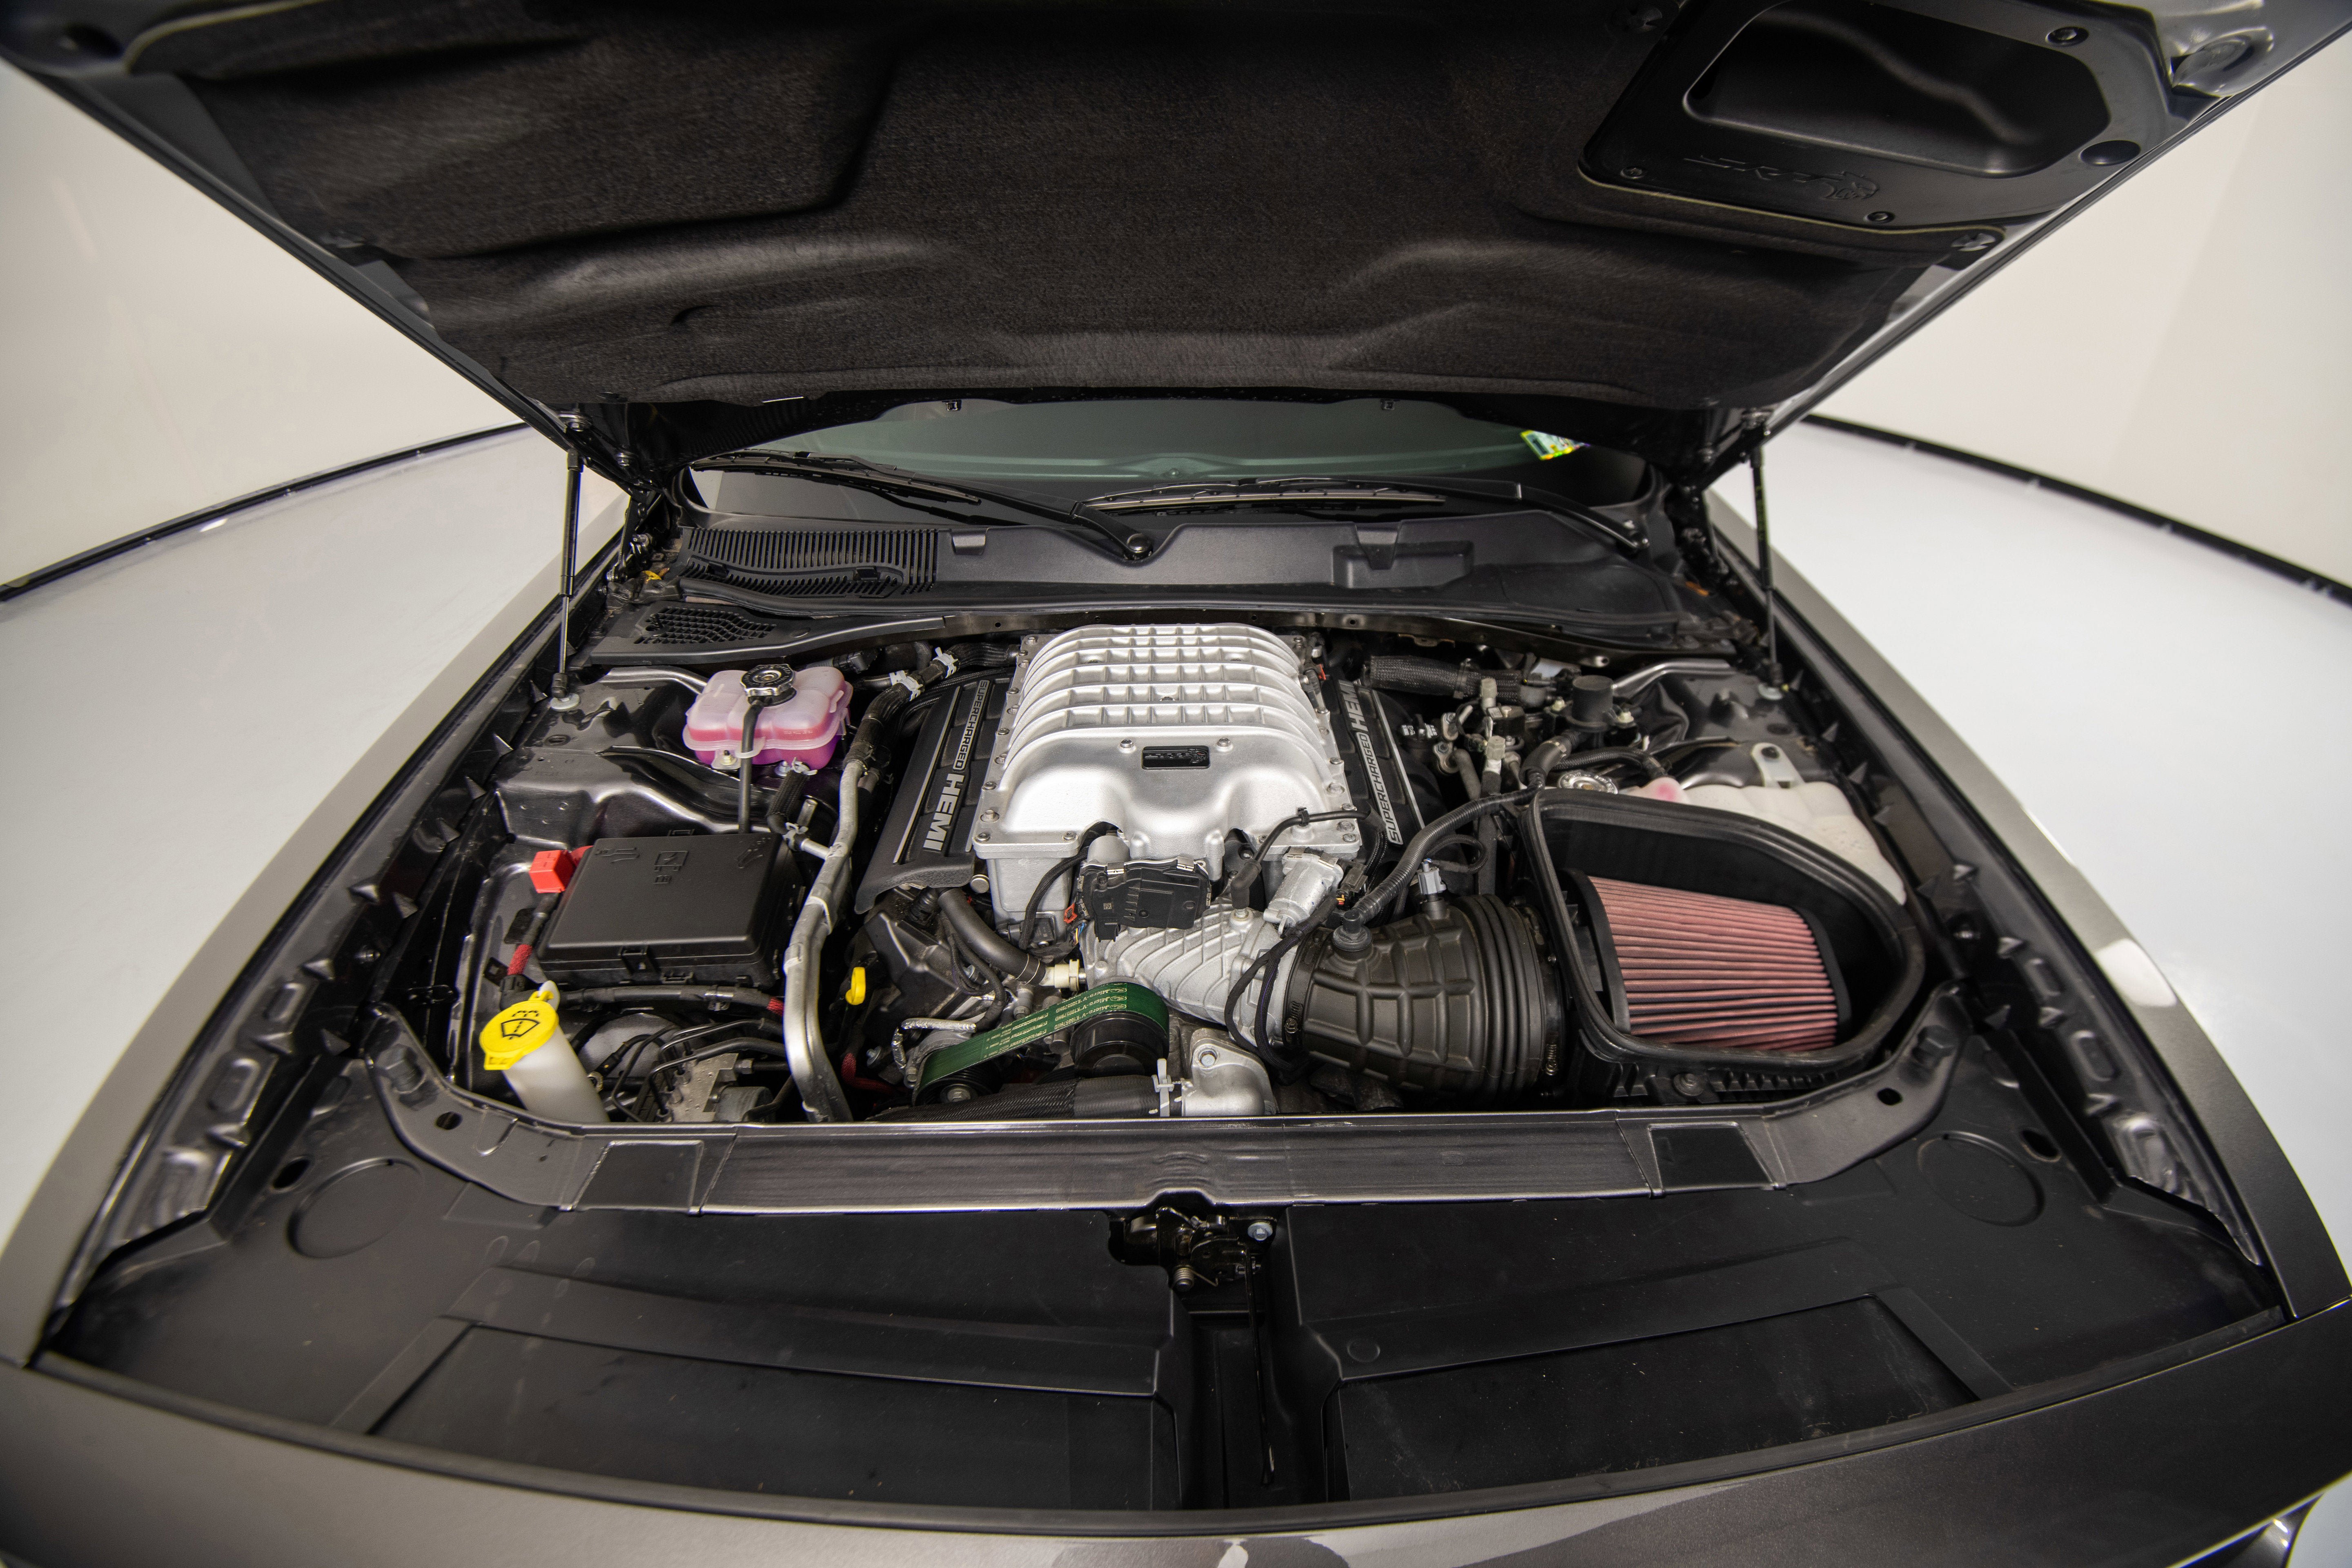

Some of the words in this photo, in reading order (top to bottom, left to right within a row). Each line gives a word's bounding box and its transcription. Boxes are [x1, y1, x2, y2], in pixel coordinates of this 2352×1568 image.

[955, 680, 988, 769] SUPERCHARGED
[1339, 680, 1368, 732] HEMI
[923, 773, 964, 851] HEMI
[1359, 733, 1401, 842] SUPERCHARGED
